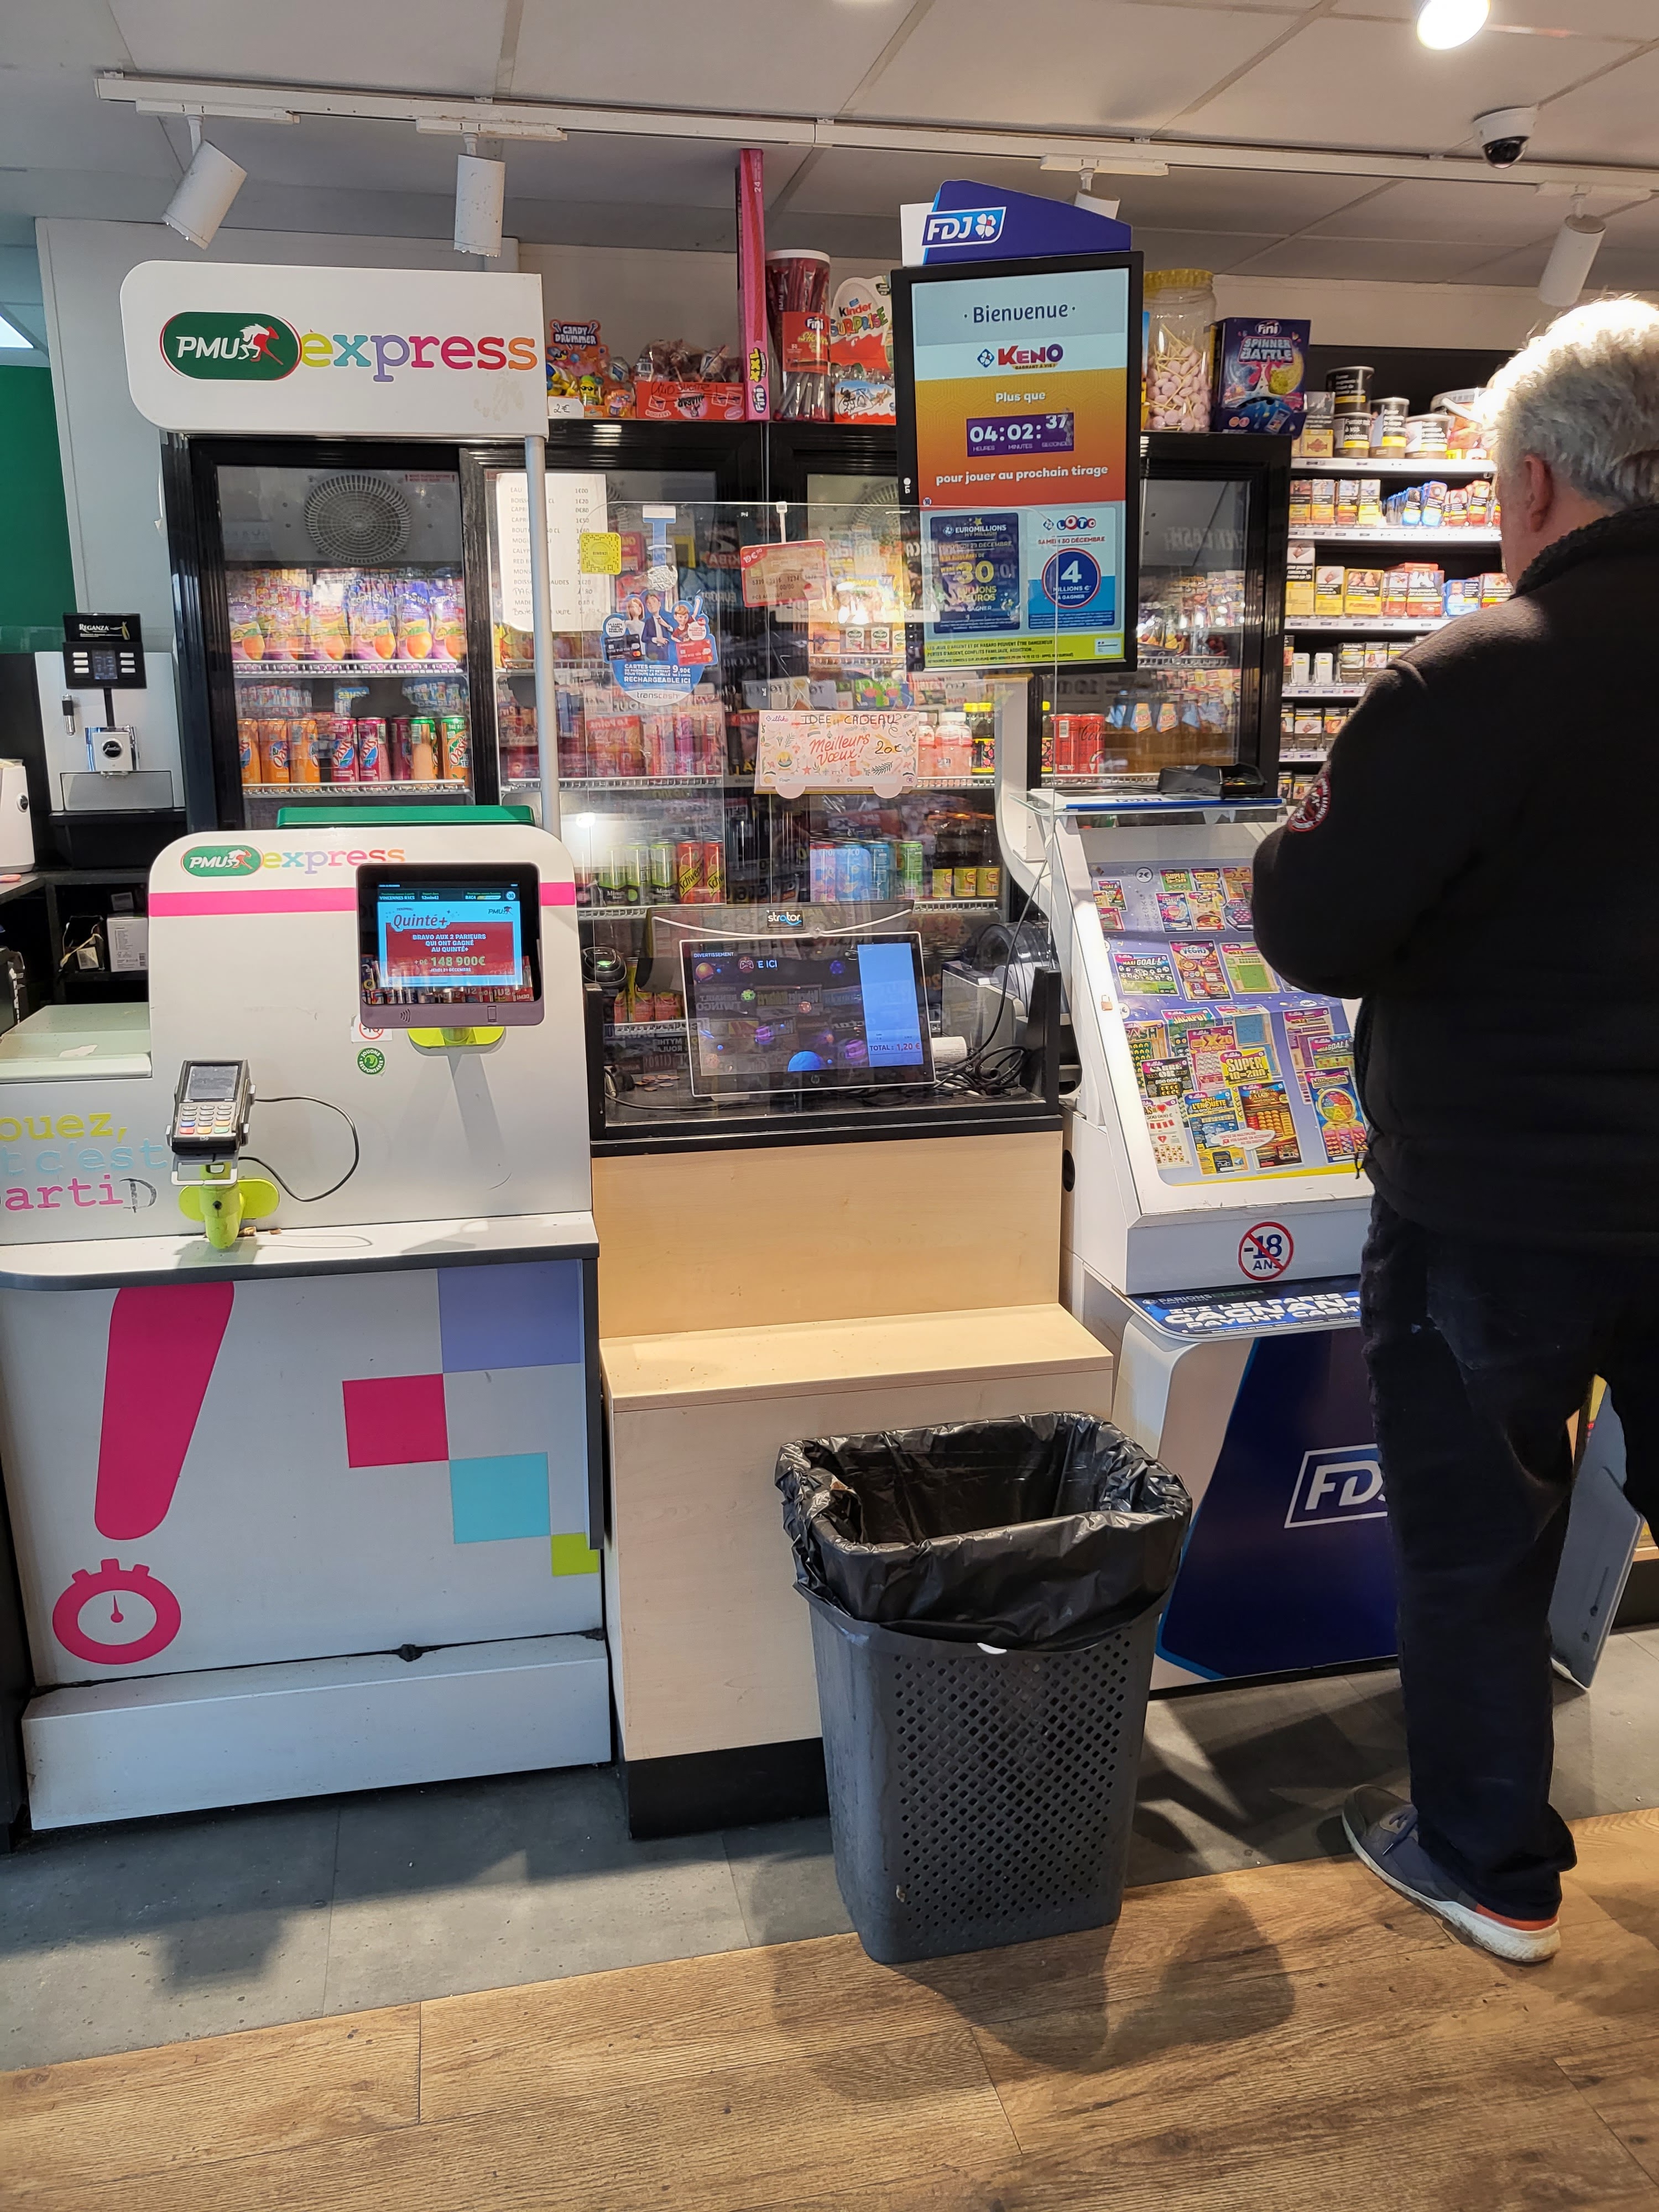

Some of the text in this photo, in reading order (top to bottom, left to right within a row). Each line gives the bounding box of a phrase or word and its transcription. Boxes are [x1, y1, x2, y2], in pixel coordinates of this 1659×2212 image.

[927, 216, 973, 241] FDJ
[973, 302, 1068, 323] Bienvenue
[807, 318, 823, 330] Fini
[830, 306, 888, 336] SURPRISE
[1258, 323, 1279, 335] Fini
[1244, 338, 1291, 348] SPINNER
[175, 331, 538, 382] PMU express
[998, 343, 1063, 366] KENO
[1240, 348, 1292, 360] BATTLE
[750, 348, 760, 382] XXL
[753, 387, 764, 411] Fini
[995, 391, 1046, 403] Plus que
[554, 404, 571, 413] 2€
[936, 465, 1108, 486] pour jouer au prochain tirage
[905, 485, 911, 494] LG
[955, 525, 1006, 534] EUROMILLIONS
[1057, 515, 1096, 530] LOTO
[956, 560, 994, 584] 30
[1061, 560, 1082, 583] 4
[79, 623, 109, 633] REGANZA
[844, 714, 898, 725] CADEAU
[810, 733, 870, 755] Meilleurs
[875, 740, 902, 754] 20€
[189, 848, 405, 874] PMU express
[393, 914, 447, 928] Quinté+
[768, 911, 802, 926] strator
[431, 957, 452, 966] 148
[456, 956, 486, 966] 900€
[766, 960, 778, 968] ICI
[1173, 1014, 1207, 1024] JACKPOT
[361, 1049, 380, 1058] JOUONS
[896, 1043, 912, 1051] 1,20
[359, 1060, 384, 1073] RESPONSABLE
[1226, 1057, 1262, 1072] SUPER
[36, 1139, 168, 1173] c'est
[1244, 1234, 1282, 1259] -18
[1253, 1259, 1280, 1271] ANS
[1160, 1294, 1212, 1303] PARIONS
[1168, 1306, 1210, 1314] ICI
[1218, 1301, 1260, 1310] LES
[1266, 1293, 1342, 1305] PARIS
[1186, 1314, 1285, 1329] PAYENT
[1292, 1305, 1358, 1318] CASH
[1305, 1459, 1386, 1511] FD
